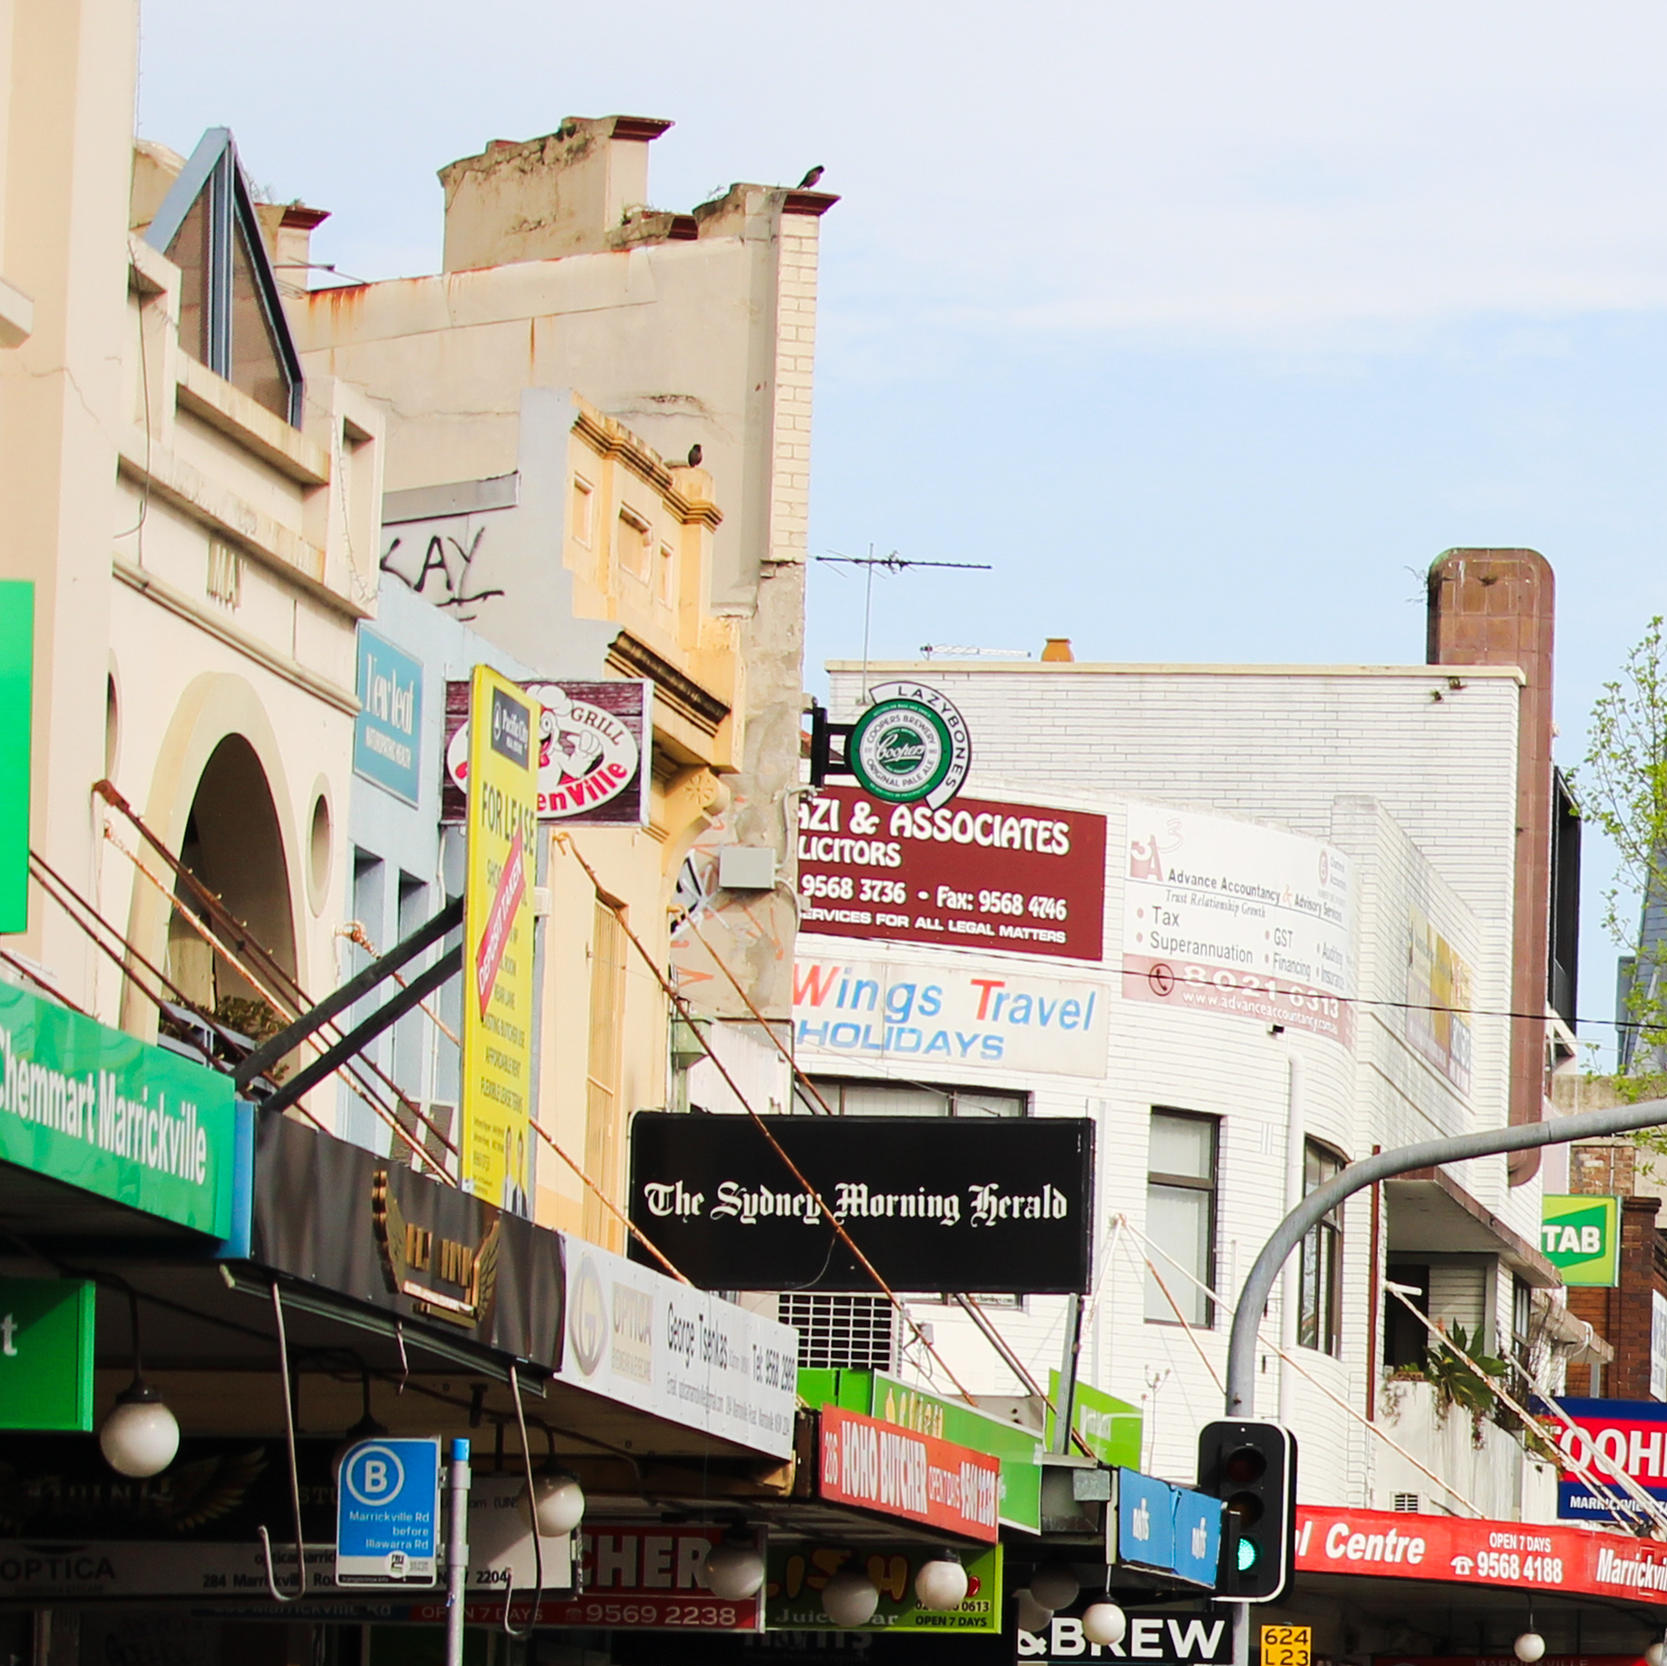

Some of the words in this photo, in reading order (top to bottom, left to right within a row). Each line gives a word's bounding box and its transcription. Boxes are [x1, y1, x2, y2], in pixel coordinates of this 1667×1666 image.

[570, 707, 626, 746] GRILL
[898, 686, 965, 787] LAZYBONES
[876, 733, 926, 763] Coopers
[481, 780, 503, 839] FOR
[849, 800, 880, 836] &
[889, 804, 1072, 856] ASSOCIATES
[801, 874, 854, 901] 9568
[859, 878, 907, 905] 3736
[936, 885, 974, 911] Fax:
[978, 890, 1024, 916] 9568
[1028, 895, 1068, 922] 4746
[1166, 888, 1188, 905] Trust
[1167, 867, 1217, 890] Advance
[1220, 876, 1281, 906] Accountancy
[1294, 892, 1322, 918] Advisory
[876, 912, 910, 928] FOR
[914, 916, 945, 931] ALL
[948, 918, 996, 937] LEGAL
[999, 924, 1067, 944] MATTERS
[1151, 905, 1180, 928] Tax
[1149, 930, 1254, 965] Superannuation
[1273, 927, 1294, 949] GST
[1272, 951, 1312, 978] Financing
[795, 963, 943, 1023] Wings
[970, 977, 1097, 1033] Travel
[1183, 964, 1278, 1002] 8021
[797, 1019, 1005, 1062] HOLIDAYS
[97, 1068, 207, 1185] Marrickville
[643, 1180, 706, 1223] The
[709, 1179, 824, 1226] Sydney
[834, 1182, 963, 1228] Morning
[967, 1182, 1068, 1228] Herald
[1542, 1223, 1601, 1255] TAB
[667, 1301, 695, 1369] George
[365, 1462, 388, 1492] B
[842, 1420, 879, 1502] HOHO
[880, 1429, 928, 1515] BUTCHER
[349, 1510, 413, 1522] Marrickville
[415, 1511, 430, 1523] Rd
[392, 1525, 429, 1537] before
[365, 1538, 411, 1550] Illawarra
[414, 1539, 429, 1550] Rd
[1325, 1521, 1428, 1565] Centre
[1488, 1531, 1517, 1549] OPEN
[1519, 1533, 1526, 1550] 7
[1526, 1536, 1552, 1553] DAYS
[0, 1556, 116, 1581] OPTICA
[476, 1570, 508, 1584] 2204
[1477, 1551, 1520, 1581] 9568
[1522, 1555, 1563, 1585] 4188
[584, 1605, 658, 1624] 9569
[664, 1606, 737, 1626] 2238
[915, 1615, 947, 1628] OPEN
[958, 1615, 988, 1629] DAYS
[1263, 1628, 1310, 1646] 624
[1264, 1648, 1310, 1666] L23
